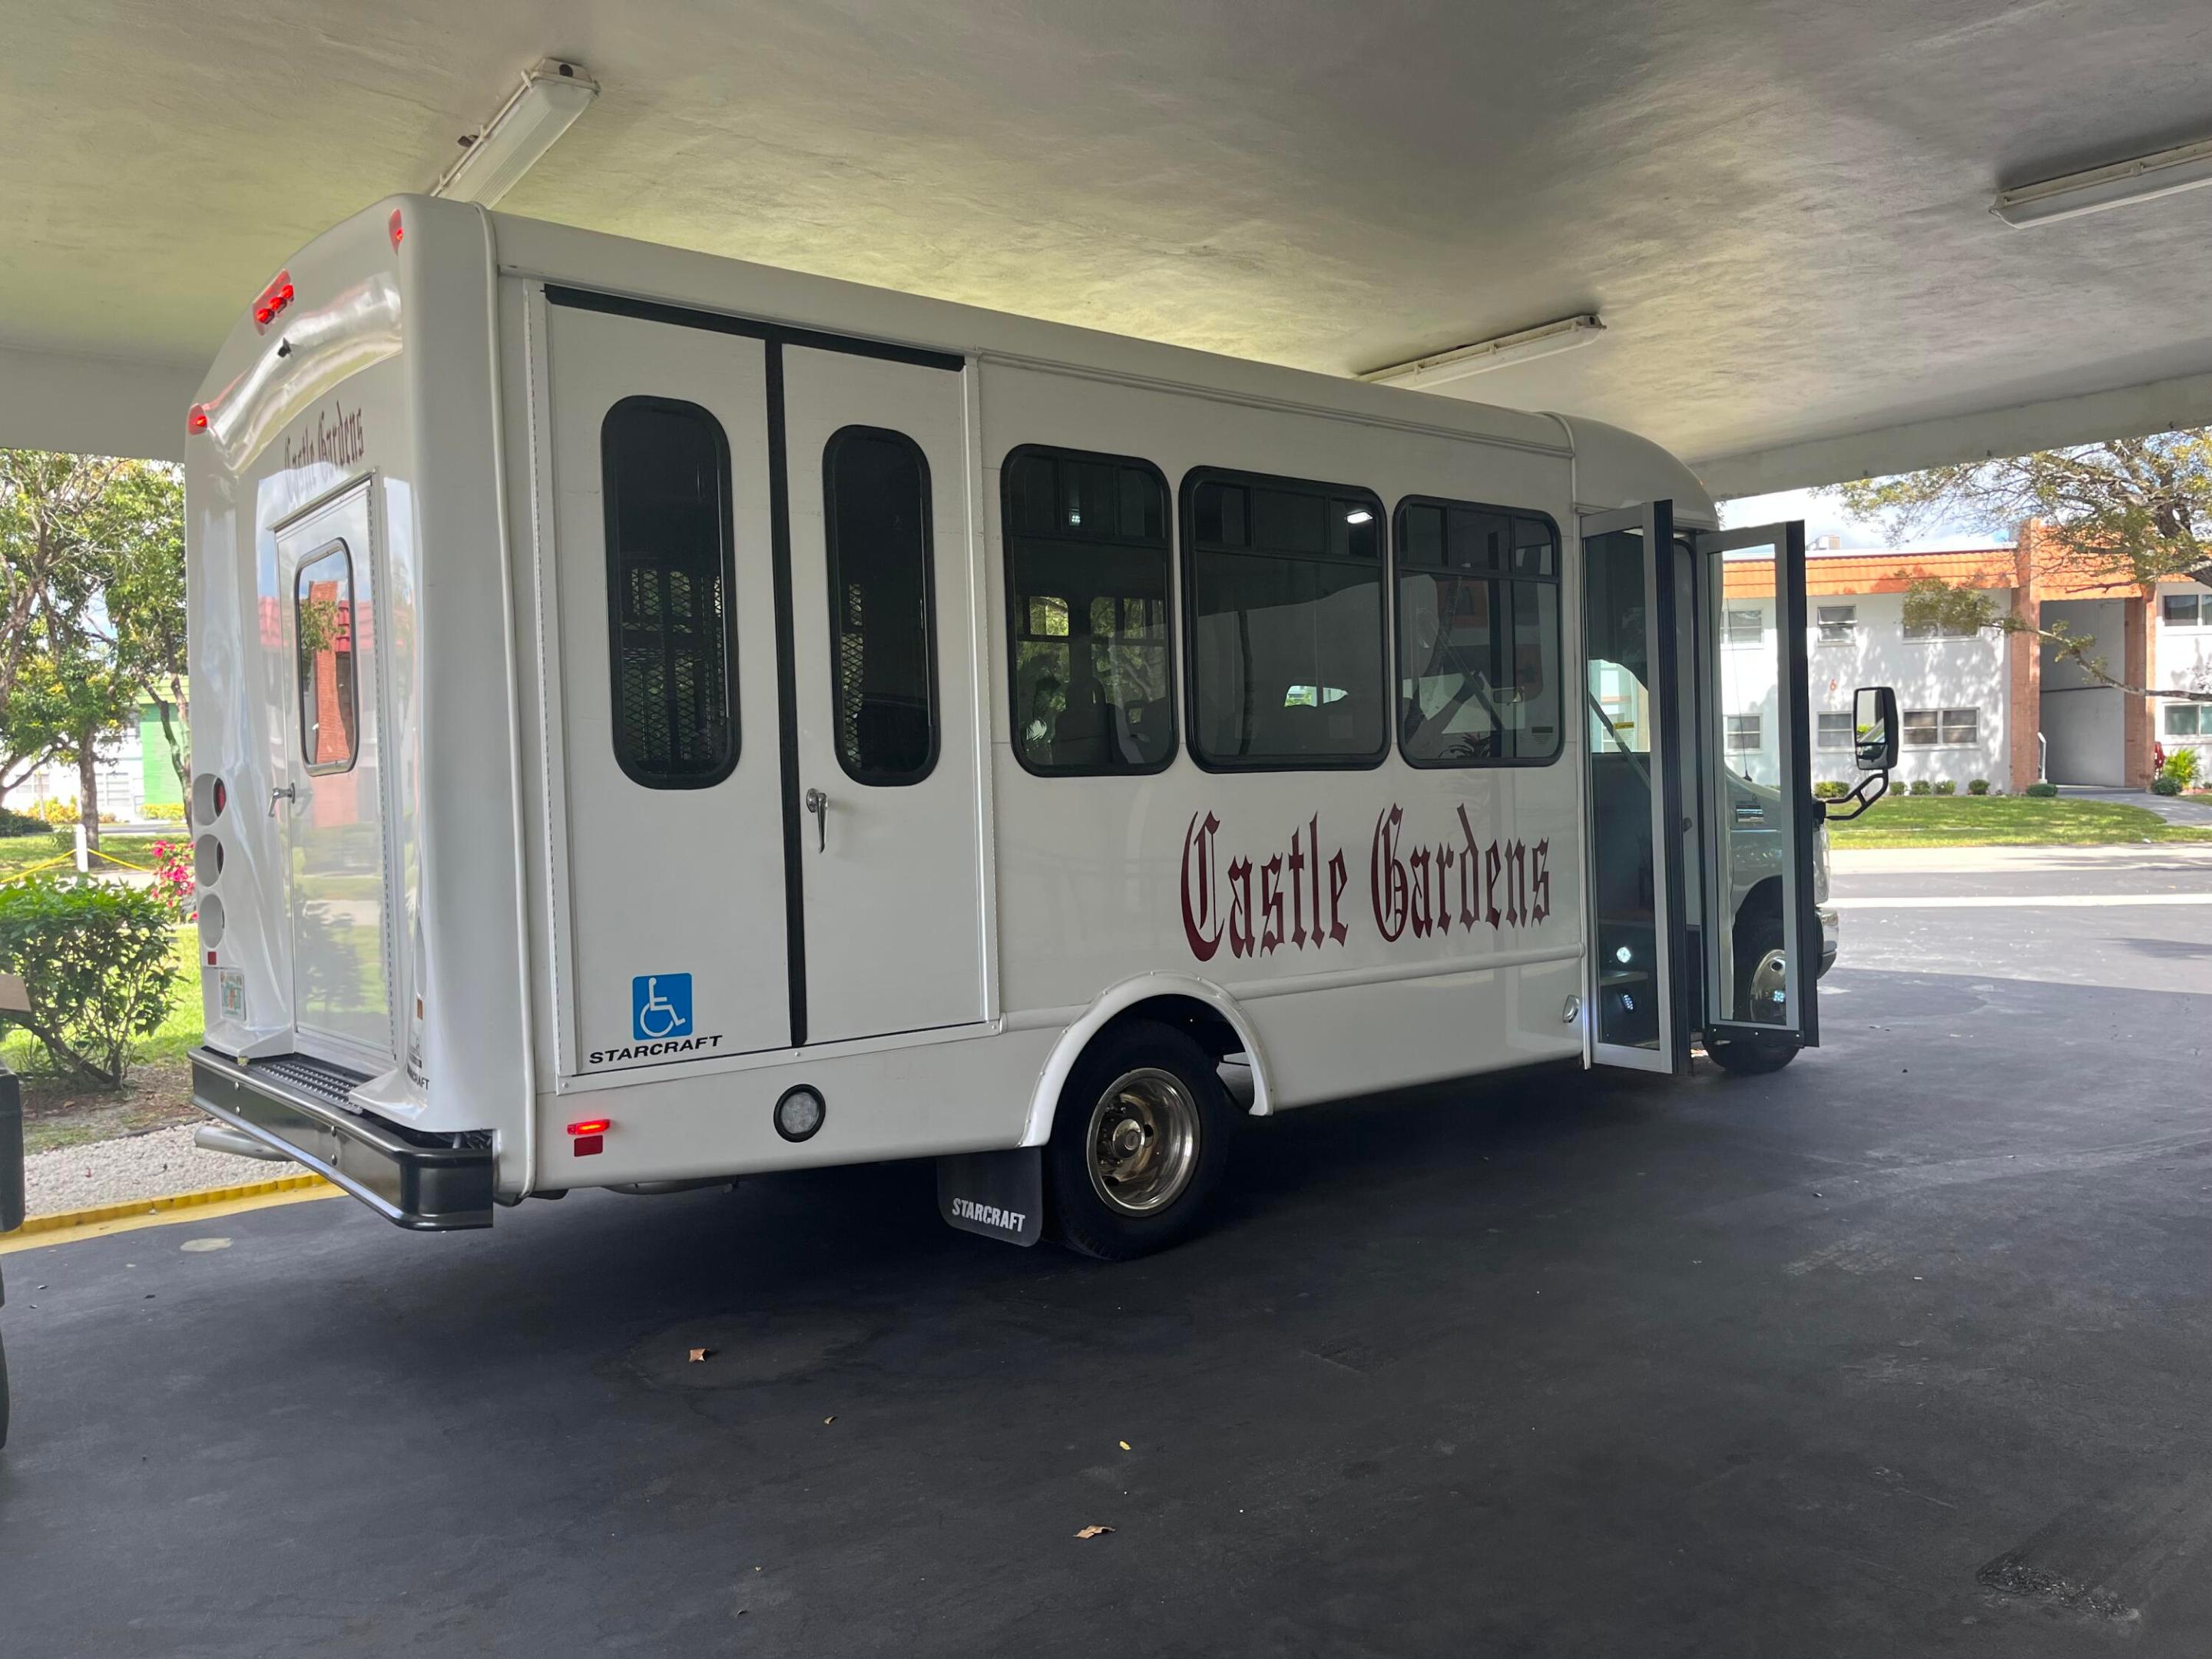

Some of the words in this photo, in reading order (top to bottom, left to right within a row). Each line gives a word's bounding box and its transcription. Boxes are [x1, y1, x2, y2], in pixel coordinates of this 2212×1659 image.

[319, 399, 364, 483] Gardens
[1181, 810, 1349, 962] Castle
[1371, 803, 1550, 942] Gardens
[589, 1035, 723, 1064] STARCRAFT
[952, 1198, 1025, 1233] STARCRAFT
